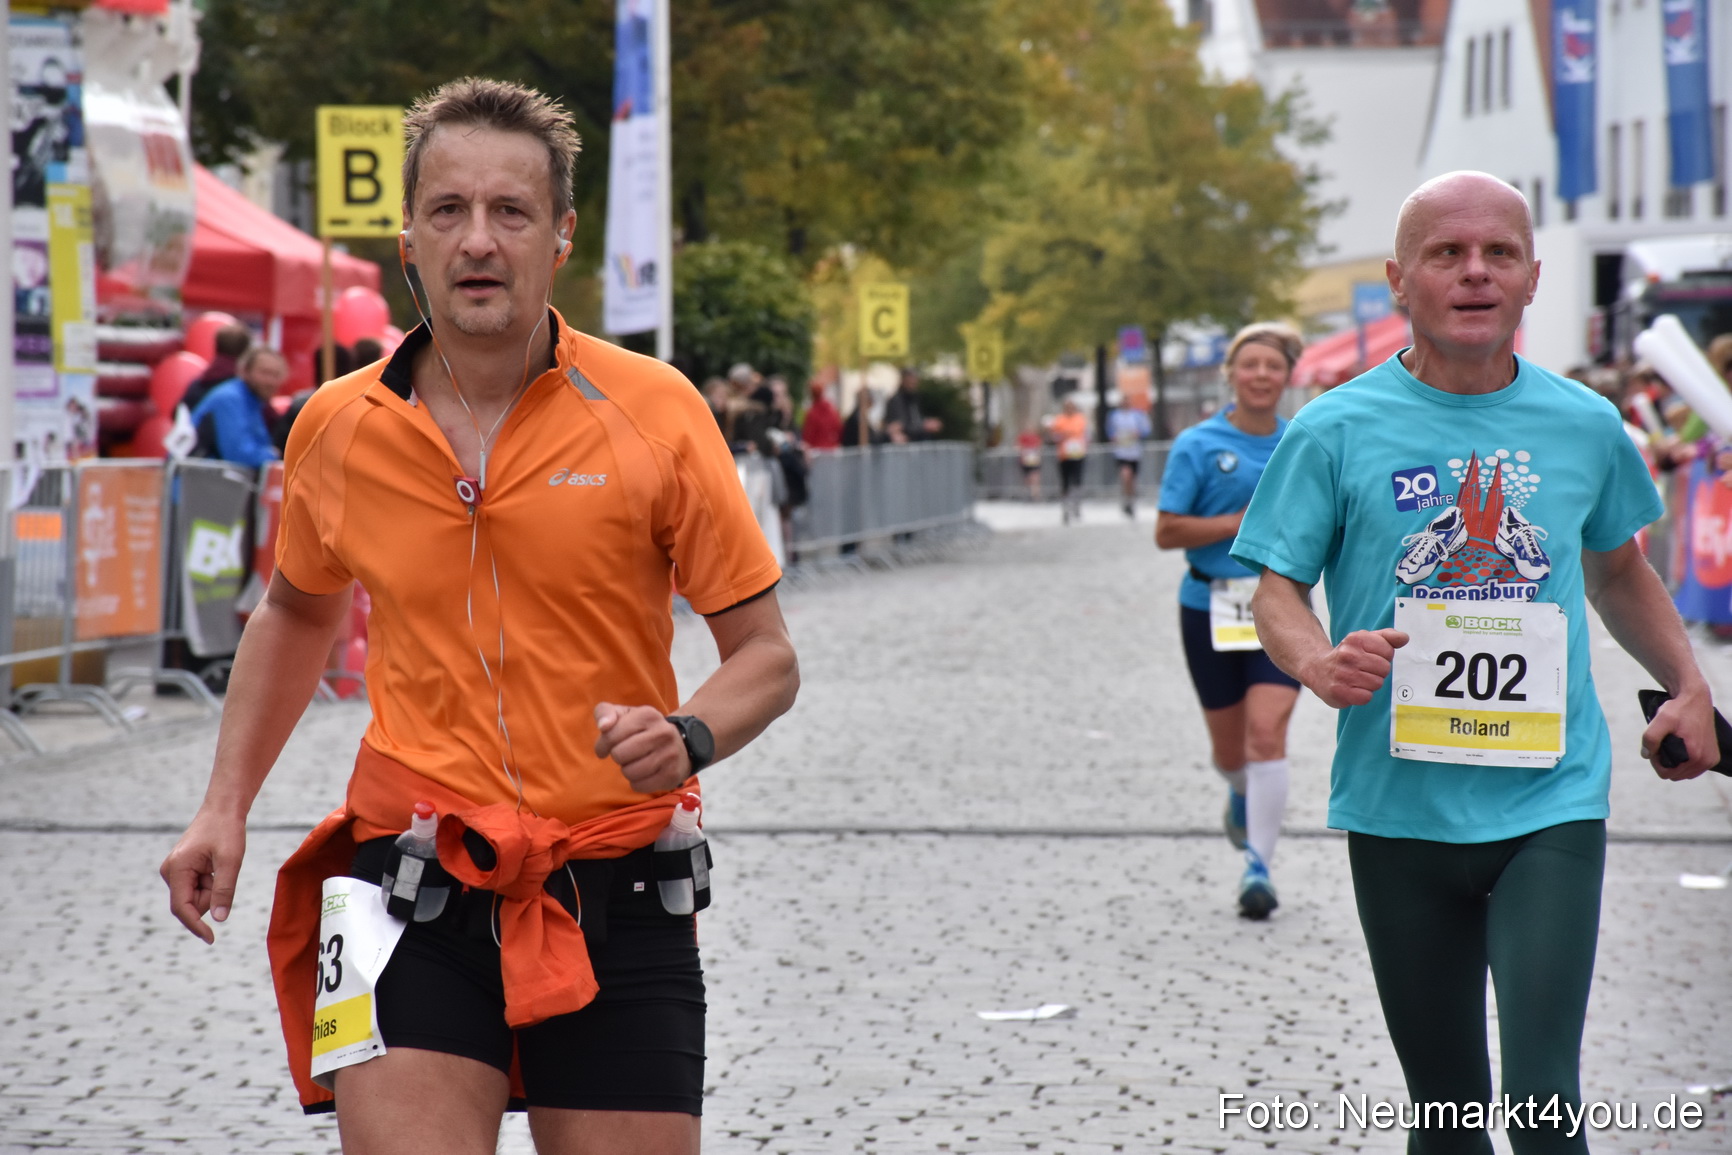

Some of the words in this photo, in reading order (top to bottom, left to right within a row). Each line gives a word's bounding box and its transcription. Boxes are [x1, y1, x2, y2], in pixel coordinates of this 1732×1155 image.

[330, 115, 392, 136] Block
[344, 149, 381, 204] B
[871, 305, 895, 338] C
[568, 474, 606, 486] asics
[1395, 472, 1437, 501] 20
[1417, 492, 1454, 513] jahre
[1463, 616, 1522, 631] BOCK
[1435, 650, 1527, 702] 202
[1402, 690, 1408, 698] C
[1450, 717, 1510, 737] Roland
[322, 894, 349, 912] CK
